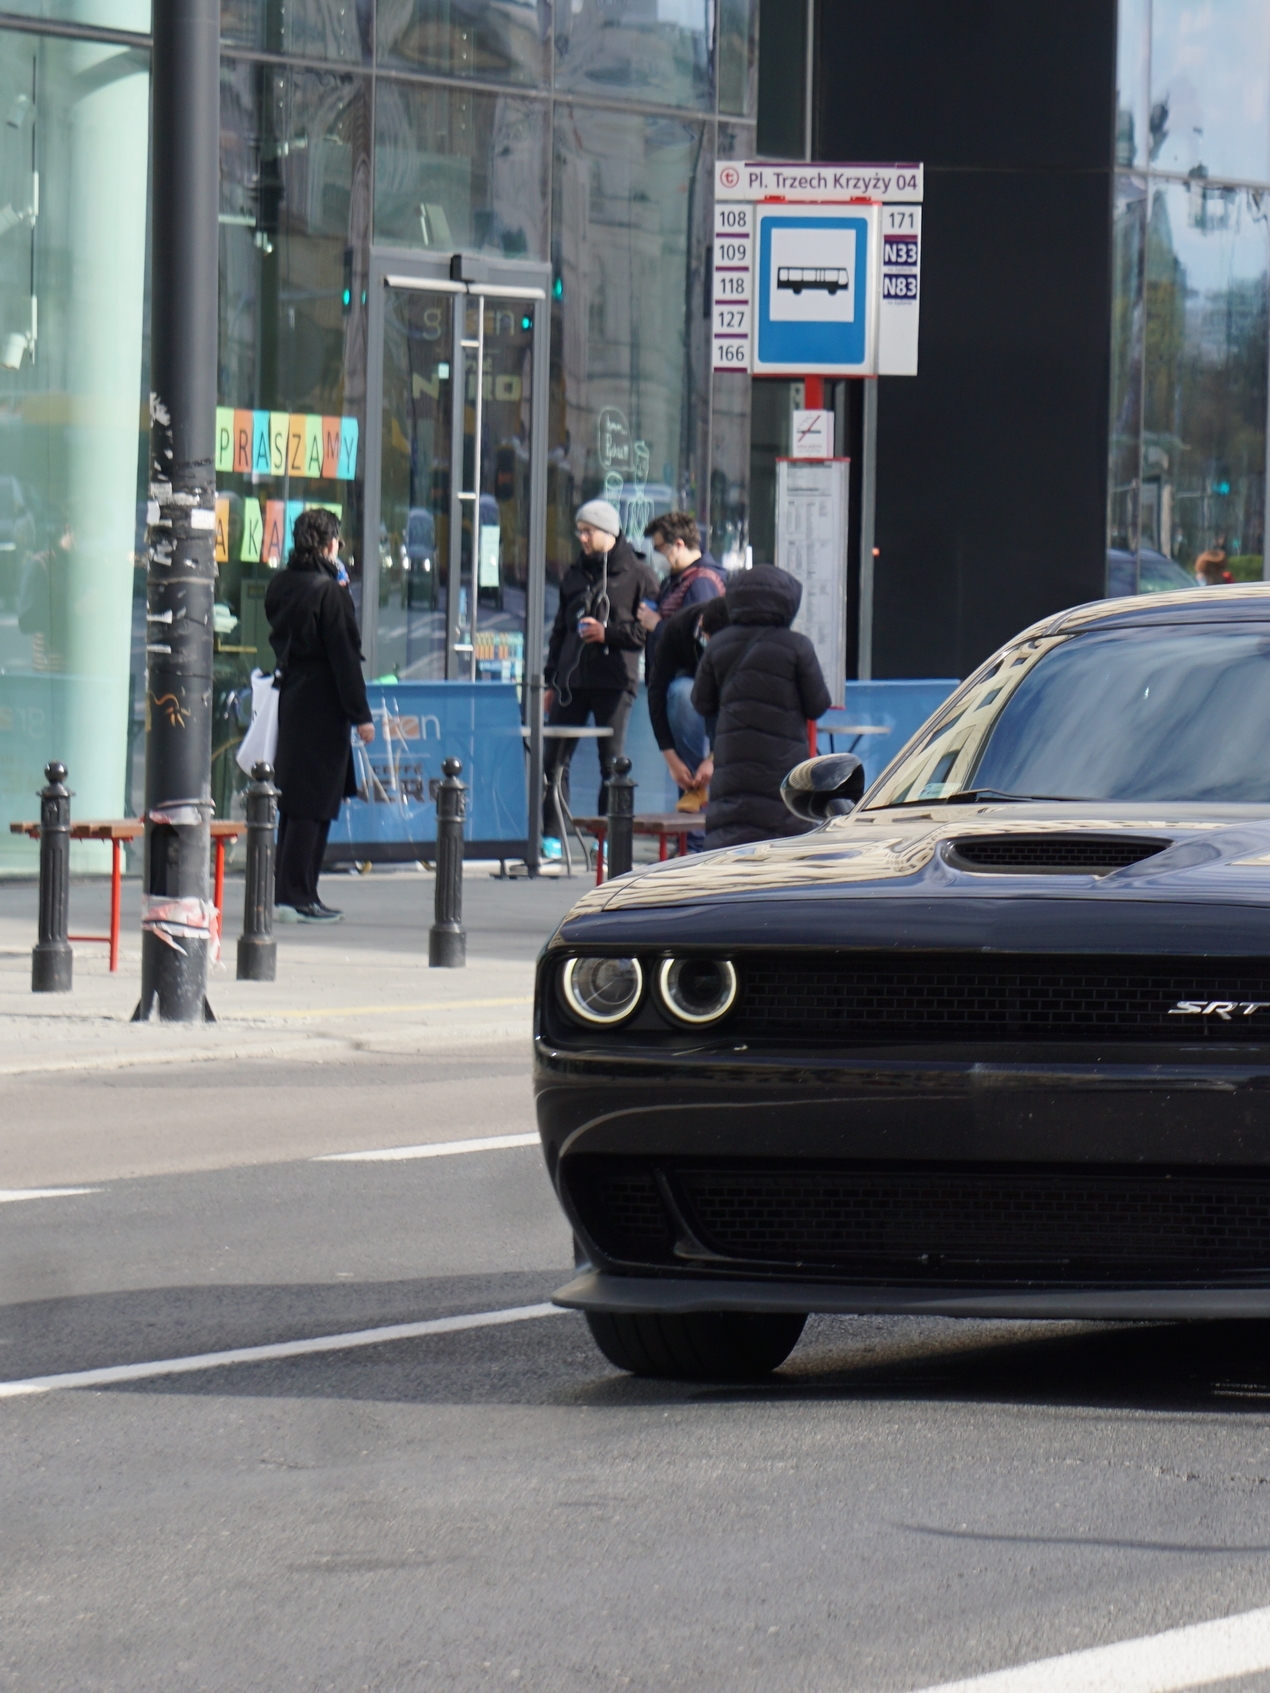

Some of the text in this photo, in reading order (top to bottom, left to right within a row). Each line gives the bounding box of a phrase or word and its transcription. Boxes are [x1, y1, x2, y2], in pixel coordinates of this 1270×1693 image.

[749, 172, 767, 188] Pl.
[774, 172, 827, 189] Trzech
[834, 172, 891, 194] Krzyży
[896, 174, 918, 190] 04
[719, 211, 747, 227] 108
[889, 212, 914, 229] 171
[719, 244, 746, 261] 109
[884, 243, 917, 263] N33
[720, 278, 745, 294] 118
[883, 276, 917, 296] N83
[718, 311, 745, 328] 127
[718, 345, 745, 361] 166
[1168, 1001, 1270, 1019] SRT
